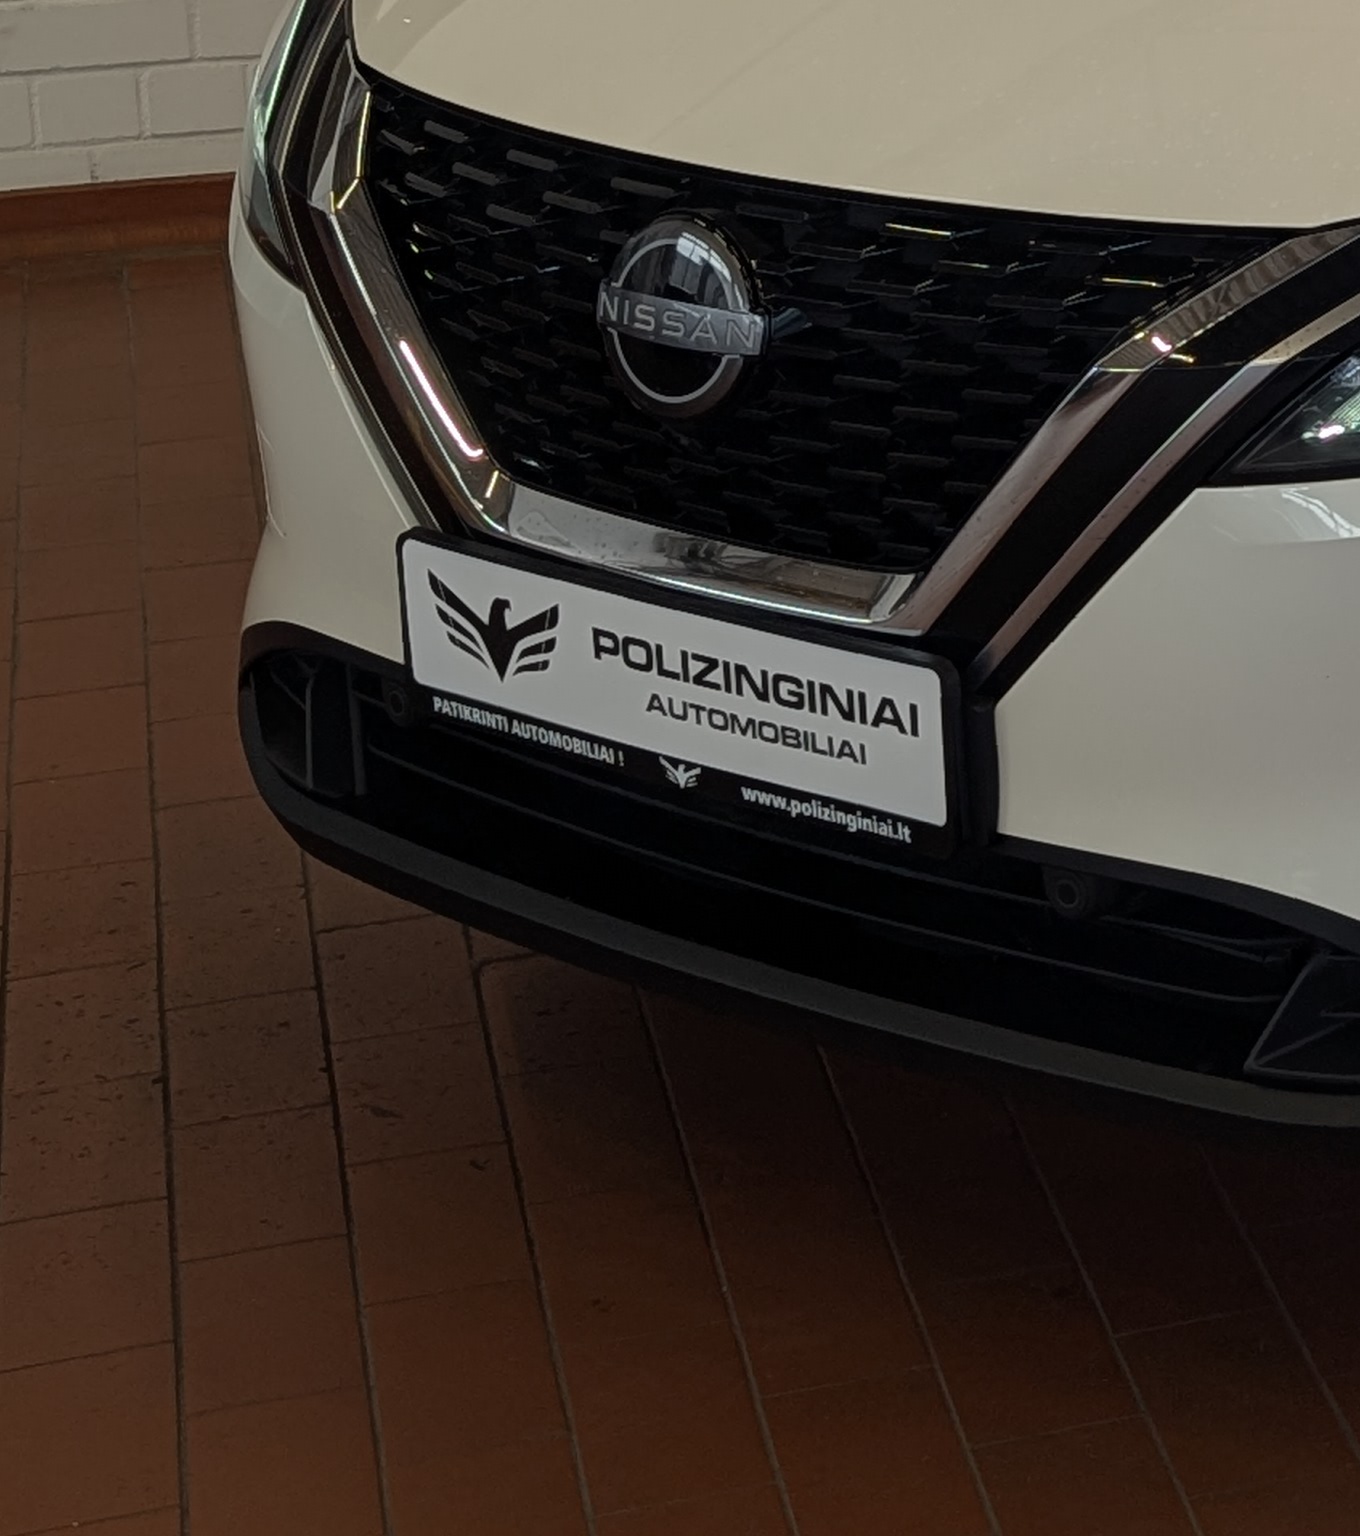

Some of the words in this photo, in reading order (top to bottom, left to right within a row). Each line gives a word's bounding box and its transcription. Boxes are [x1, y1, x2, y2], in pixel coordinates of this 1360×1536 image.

[600, 291, 757, 349] NISSAN
[590, 626, 921, 738] POLIZINGINIAI
[432, 696, 509, 734] PATIKRINTI
[511, 716, 616, 766] AUTOMOBILIAI
[645, 692, 868, 765] AUTOMOBILIAI
[740, 785, 913, 845] www.polizinginiai.lt
